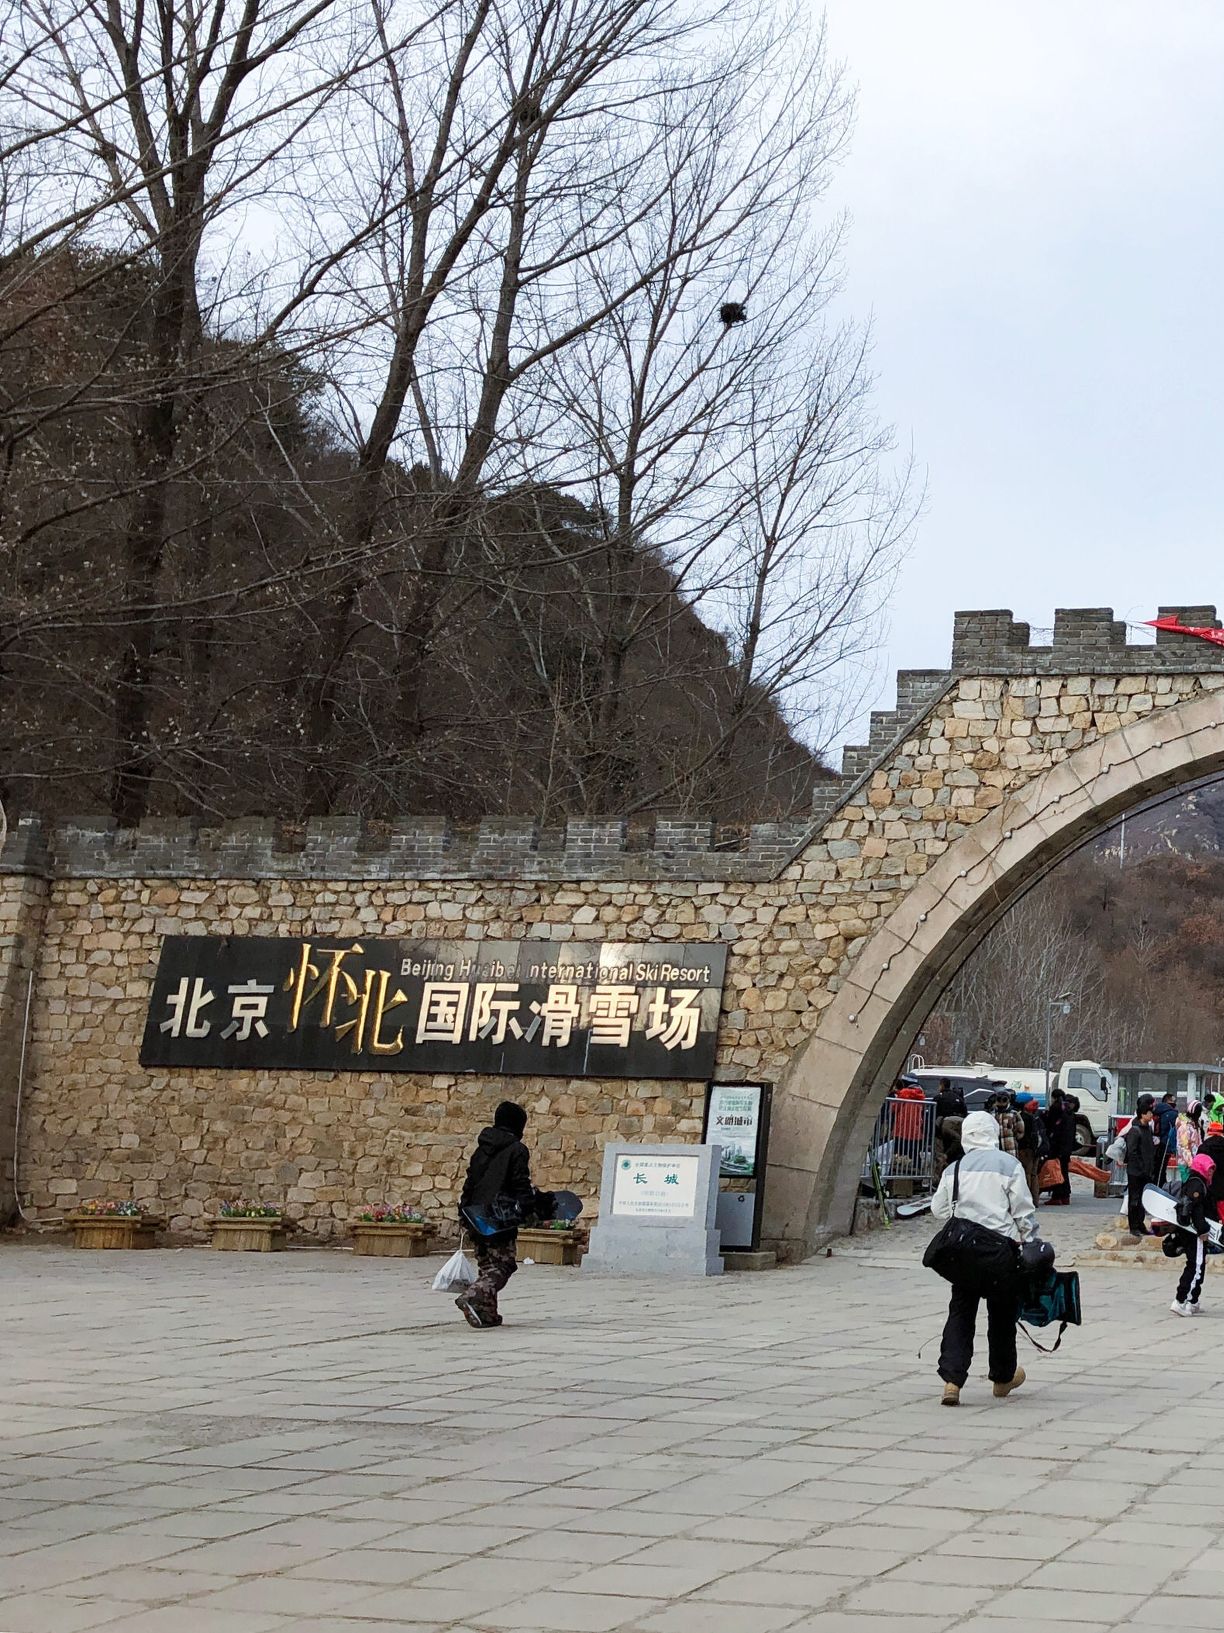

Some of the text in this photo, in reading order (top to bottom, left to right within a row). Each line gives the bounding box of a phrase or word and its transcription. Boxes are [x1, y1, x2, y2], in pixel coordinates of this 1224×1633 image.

[400, 959, 455, 981] Beijing
[635, 963, 658, 983] Ski
[660, 963, 711, 984] Resort
[633, 1172, 680, 1185] 长城
